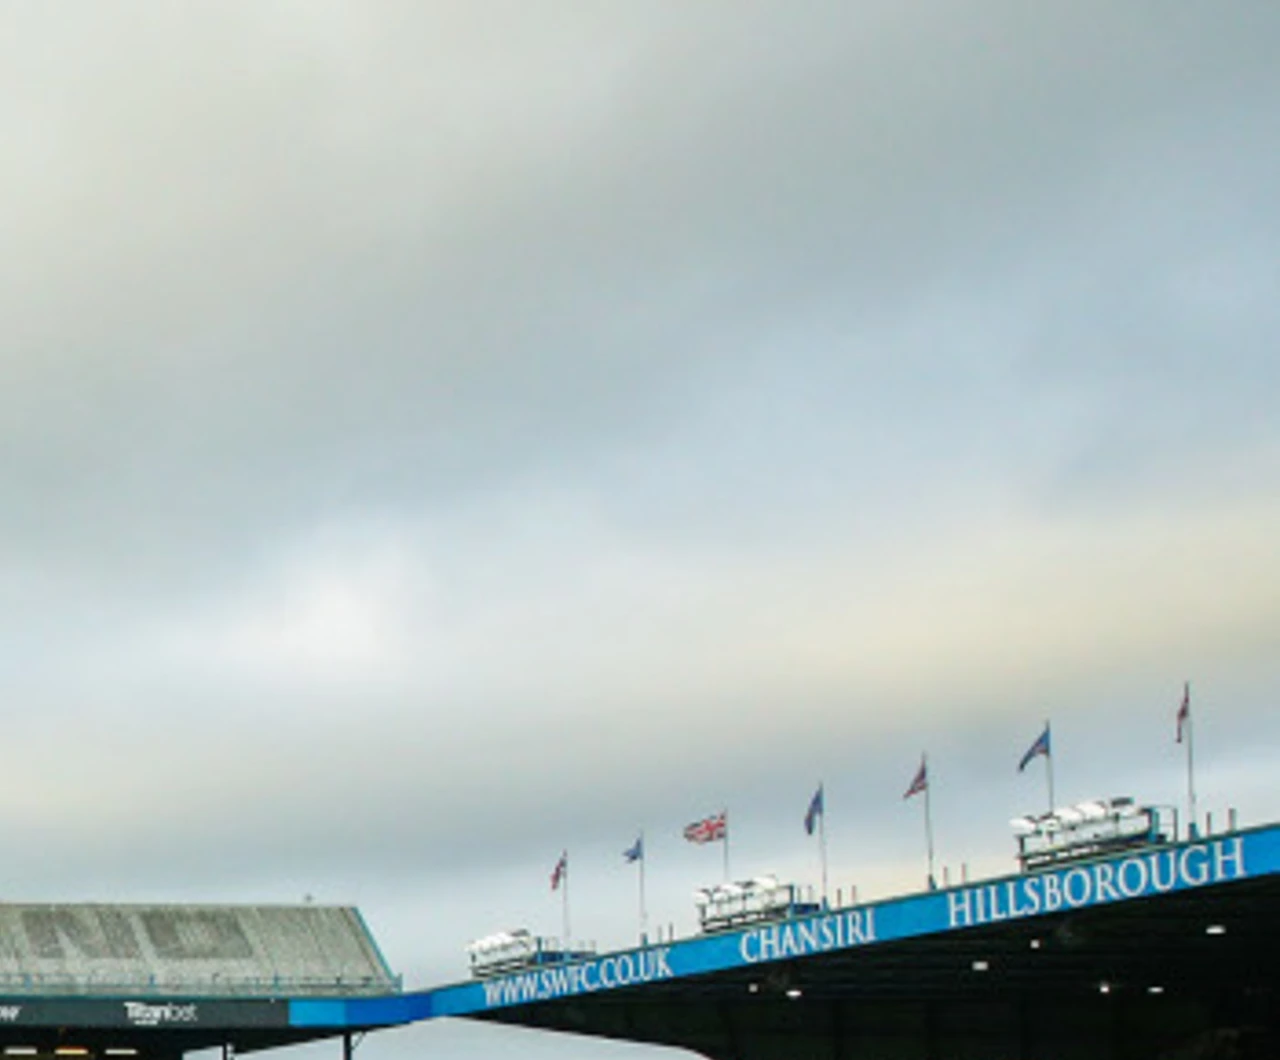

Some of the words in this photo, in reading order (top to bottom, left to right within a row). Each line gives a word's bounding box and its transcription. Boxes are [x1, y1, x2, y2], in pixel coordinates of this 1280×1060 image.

[947, 838, 1248, 928] HILLSBOROUGH
[739, 906, 877, 963] CHANSIRI
[483, 948, 674, 1007] WWW.SWFC.CO.UK
